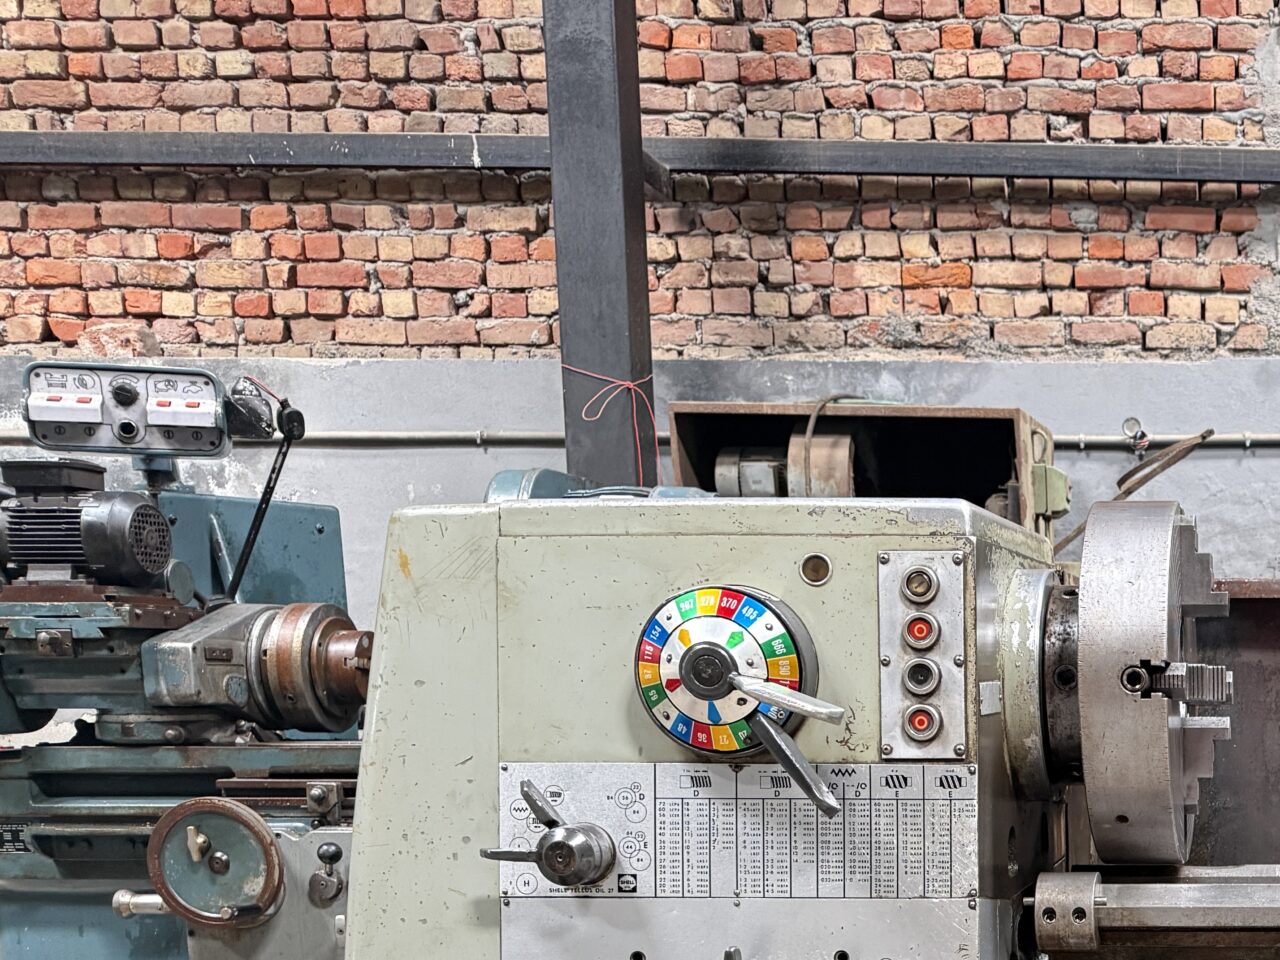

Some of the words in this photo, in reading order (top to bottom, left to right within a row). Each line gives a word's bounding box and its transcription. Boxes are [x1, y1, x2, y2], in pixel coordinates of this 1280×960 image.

[721, 597, 738, 609] 370
[741, 605, 759, 620] 495
[650, 625, 662, 640] 154
[644, 645, 654, 659] 115
[677, 723, 688, 734] 48
[697, 732, 708, 743] 36
